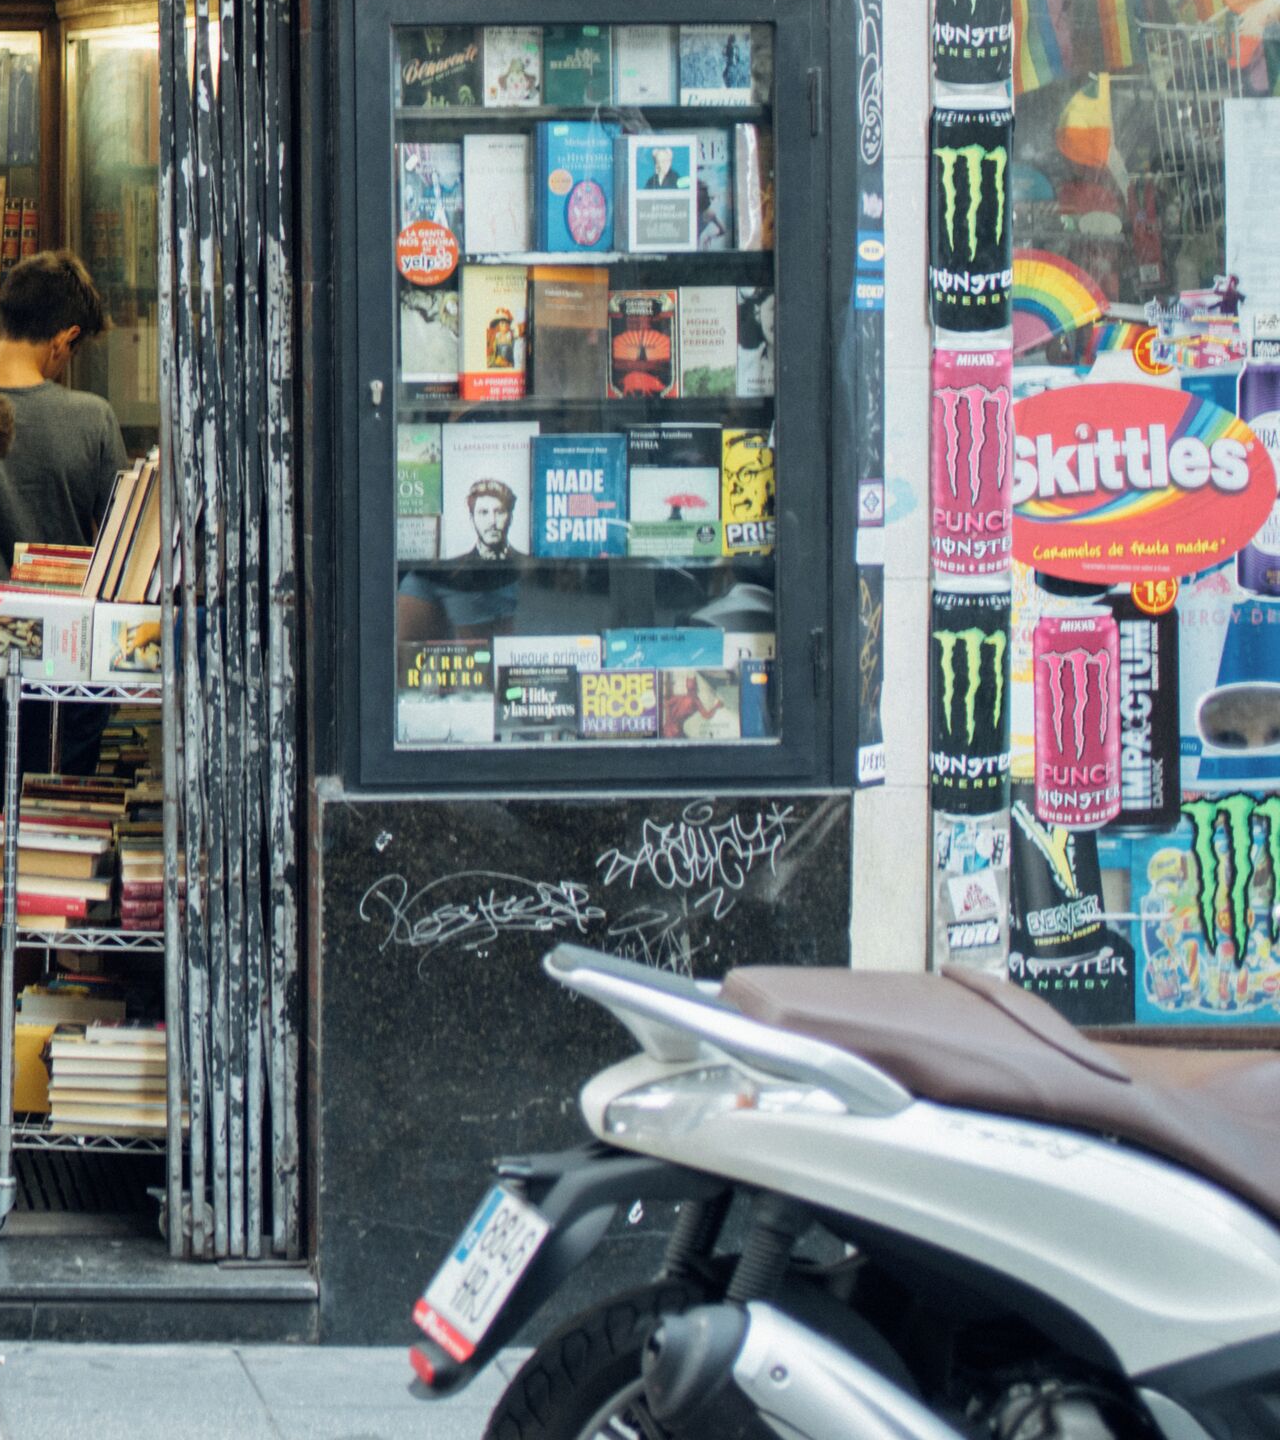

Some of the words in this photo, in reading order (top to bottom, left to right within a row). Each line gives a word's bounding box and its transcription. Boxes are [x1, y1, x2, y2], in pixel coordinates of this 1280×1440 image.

[401, 255, 437, 272] yelp
[1013, 423, 1250, 498] Skittles
[545, 469, 605, 493] MADE
[545, 493, 568, 517] IN
[545, 517, 608, 542] SPAIN
[1108, 541, 1124, 558] de
[581, 673, 654, 696] PADRE
[582, 694, 644, 718] RICO
[1041, 762, 1119, 786] PUNCH
[1023, 978, 1110, 991] ENERGY
